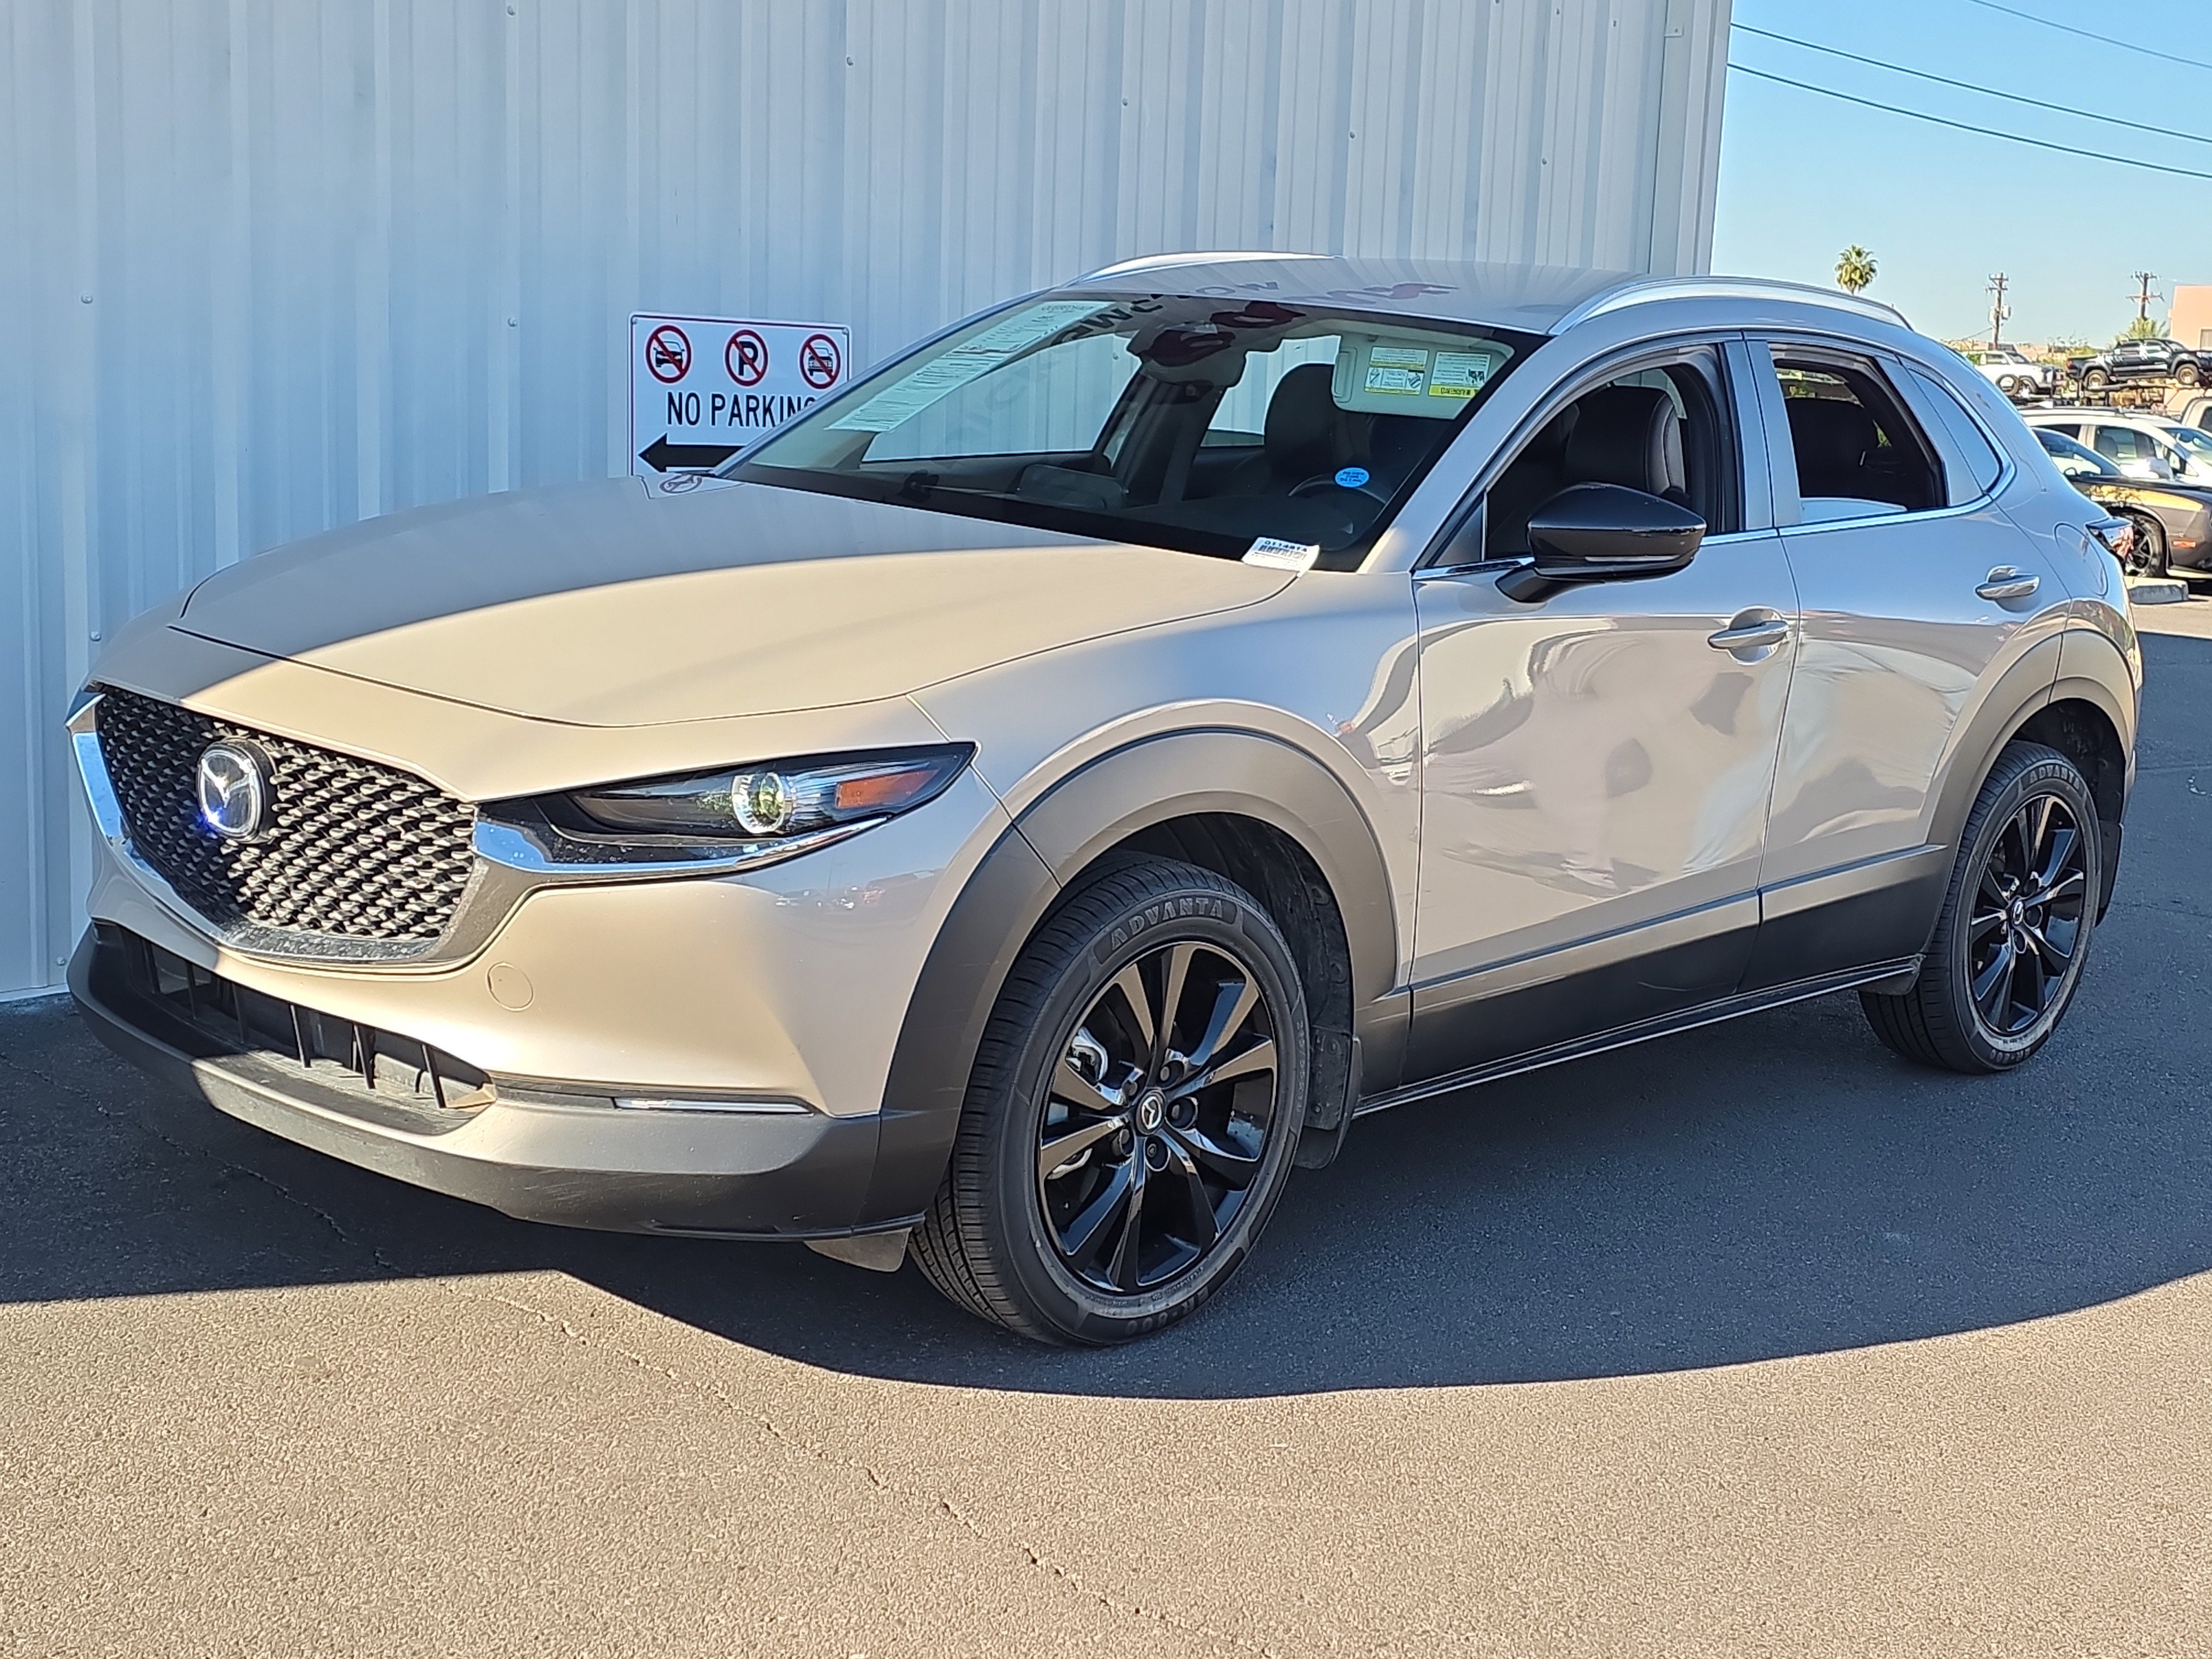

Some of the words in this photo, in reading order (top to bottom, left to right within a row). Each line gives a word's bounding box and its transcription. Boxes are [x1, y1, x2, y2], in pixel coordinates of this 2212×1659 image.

[667, 391, 700, 426] NO
[711, 394, 815, 428] PARKIN
[2029, 765, 2079, 790] ADVANTA
[1111, 897, 1223, 950] ADVANTA
